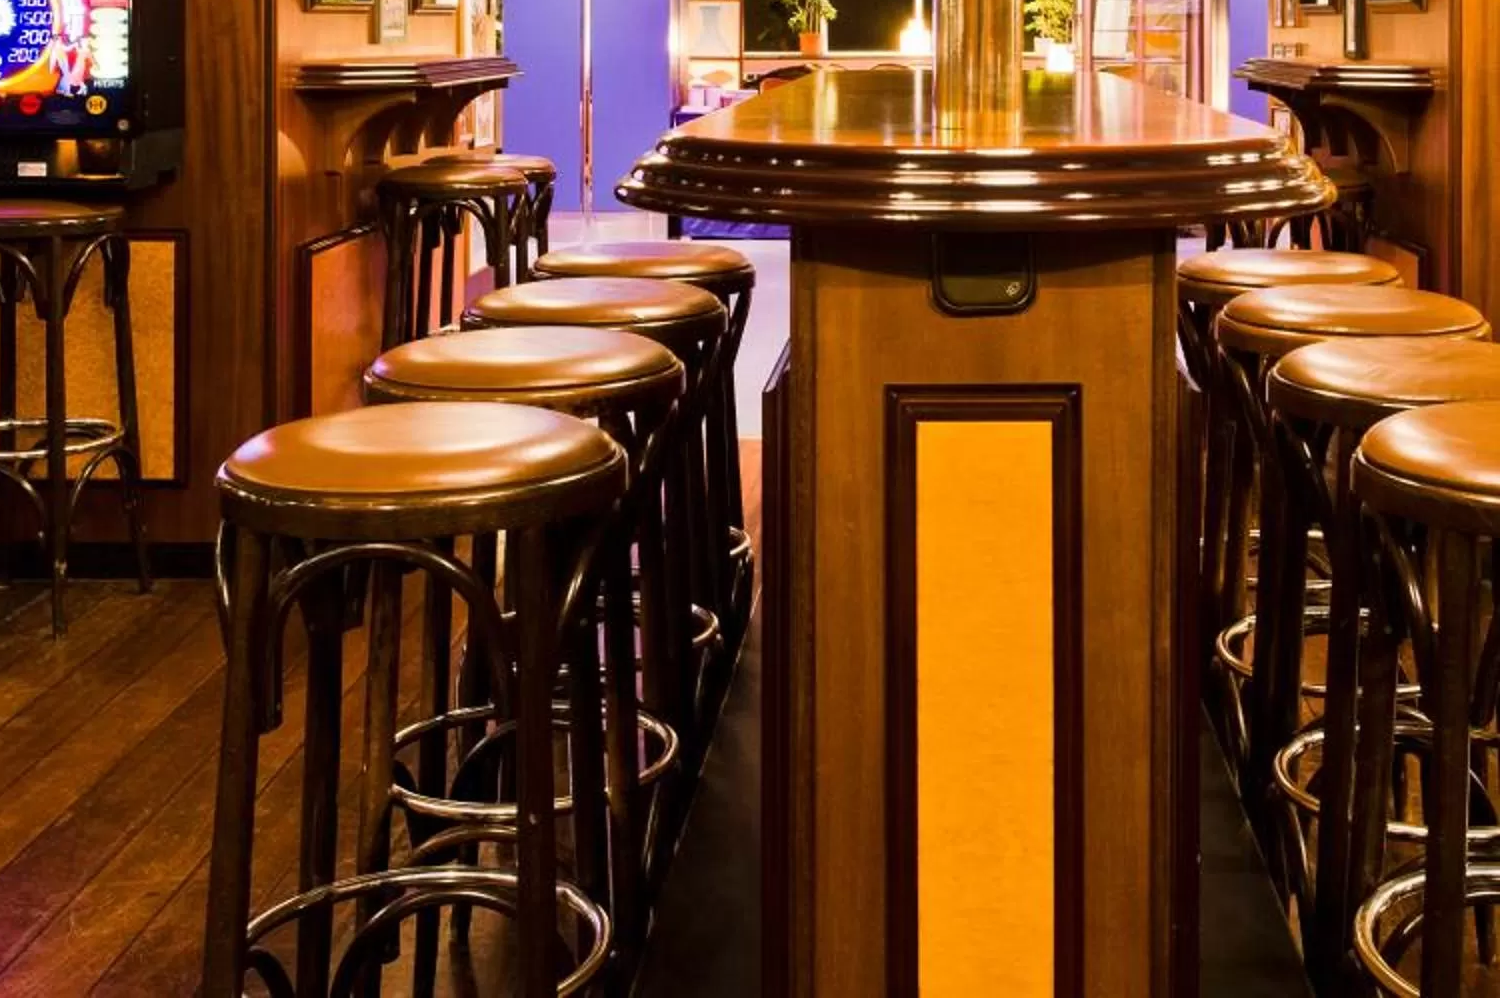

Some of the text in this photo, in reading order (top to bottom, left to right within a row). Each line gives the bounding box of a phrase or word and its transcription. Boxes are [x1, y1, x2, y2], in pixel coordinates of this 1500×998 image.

[19, 11, 53, 25] 1500
[18, 29, 50, 44] 200
[8, 48, 39, 63] 200
